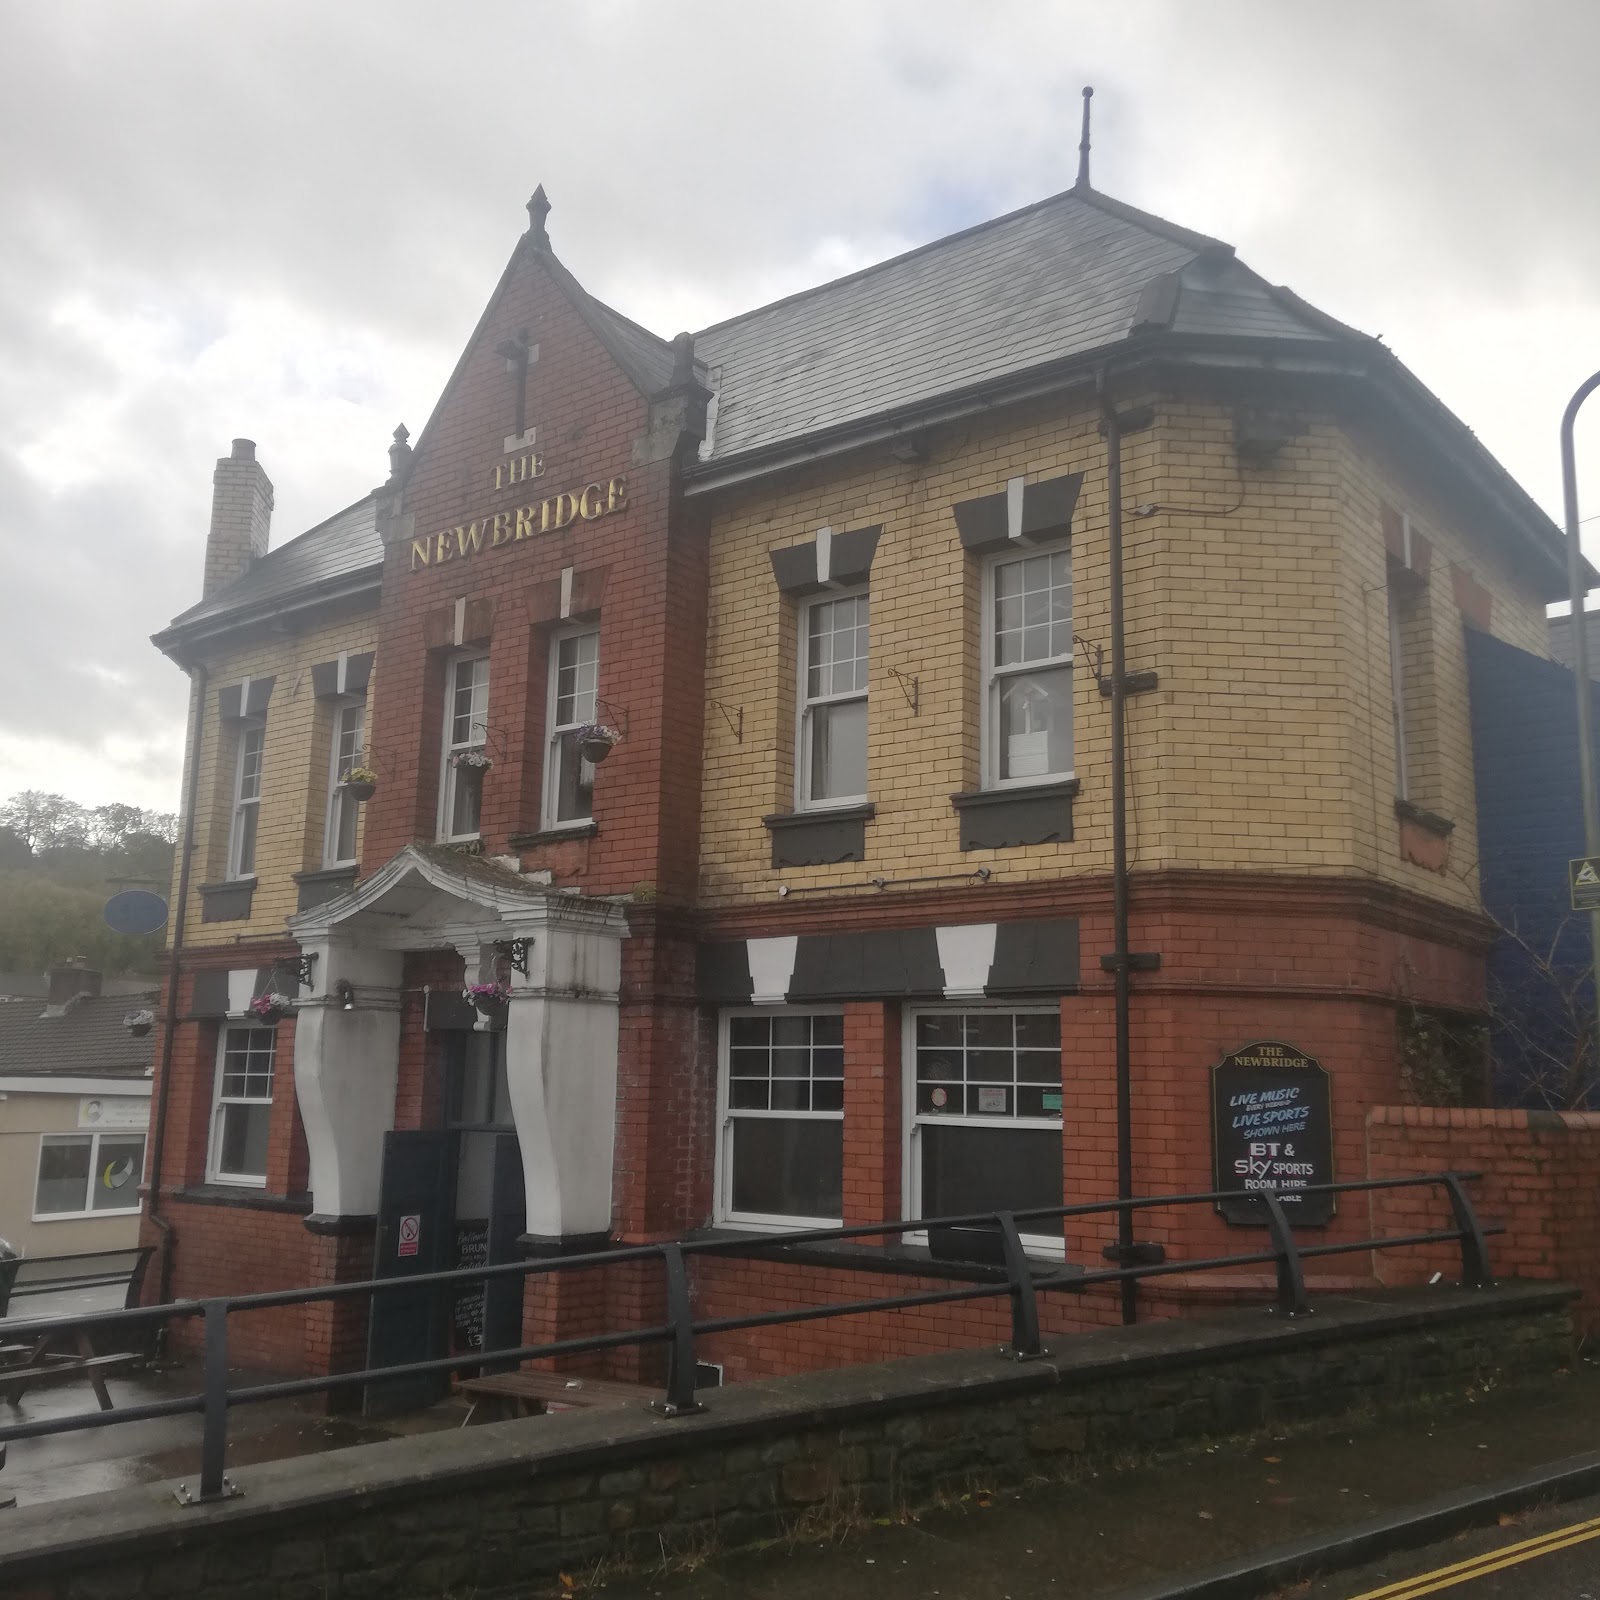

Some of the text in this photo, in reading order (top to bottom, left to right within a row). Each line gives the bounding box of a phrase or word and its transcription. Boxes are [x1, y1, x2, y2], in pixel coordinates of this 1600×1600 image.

[490, 451, 547, 490] THE
[409, 475, 630, 572] NEWBRIDGE
[1257, 1047, 1284, 1057] THE
[1234, 1056, 1309, 1068] NEWBRIDGE
[1229, 1087, 1300, 1107] LIVE MUSIC
[1232, 1106, 1311, 1128] LIVE SPORTS
[1243, 1121, 1306, 1140] SHOWN HERE
[1250, 1143, 1295, 1157] BT &
[1273, 1163, 1314, 1175] SPORTS
[1245, 1179, 1277, 1190] ROOM
